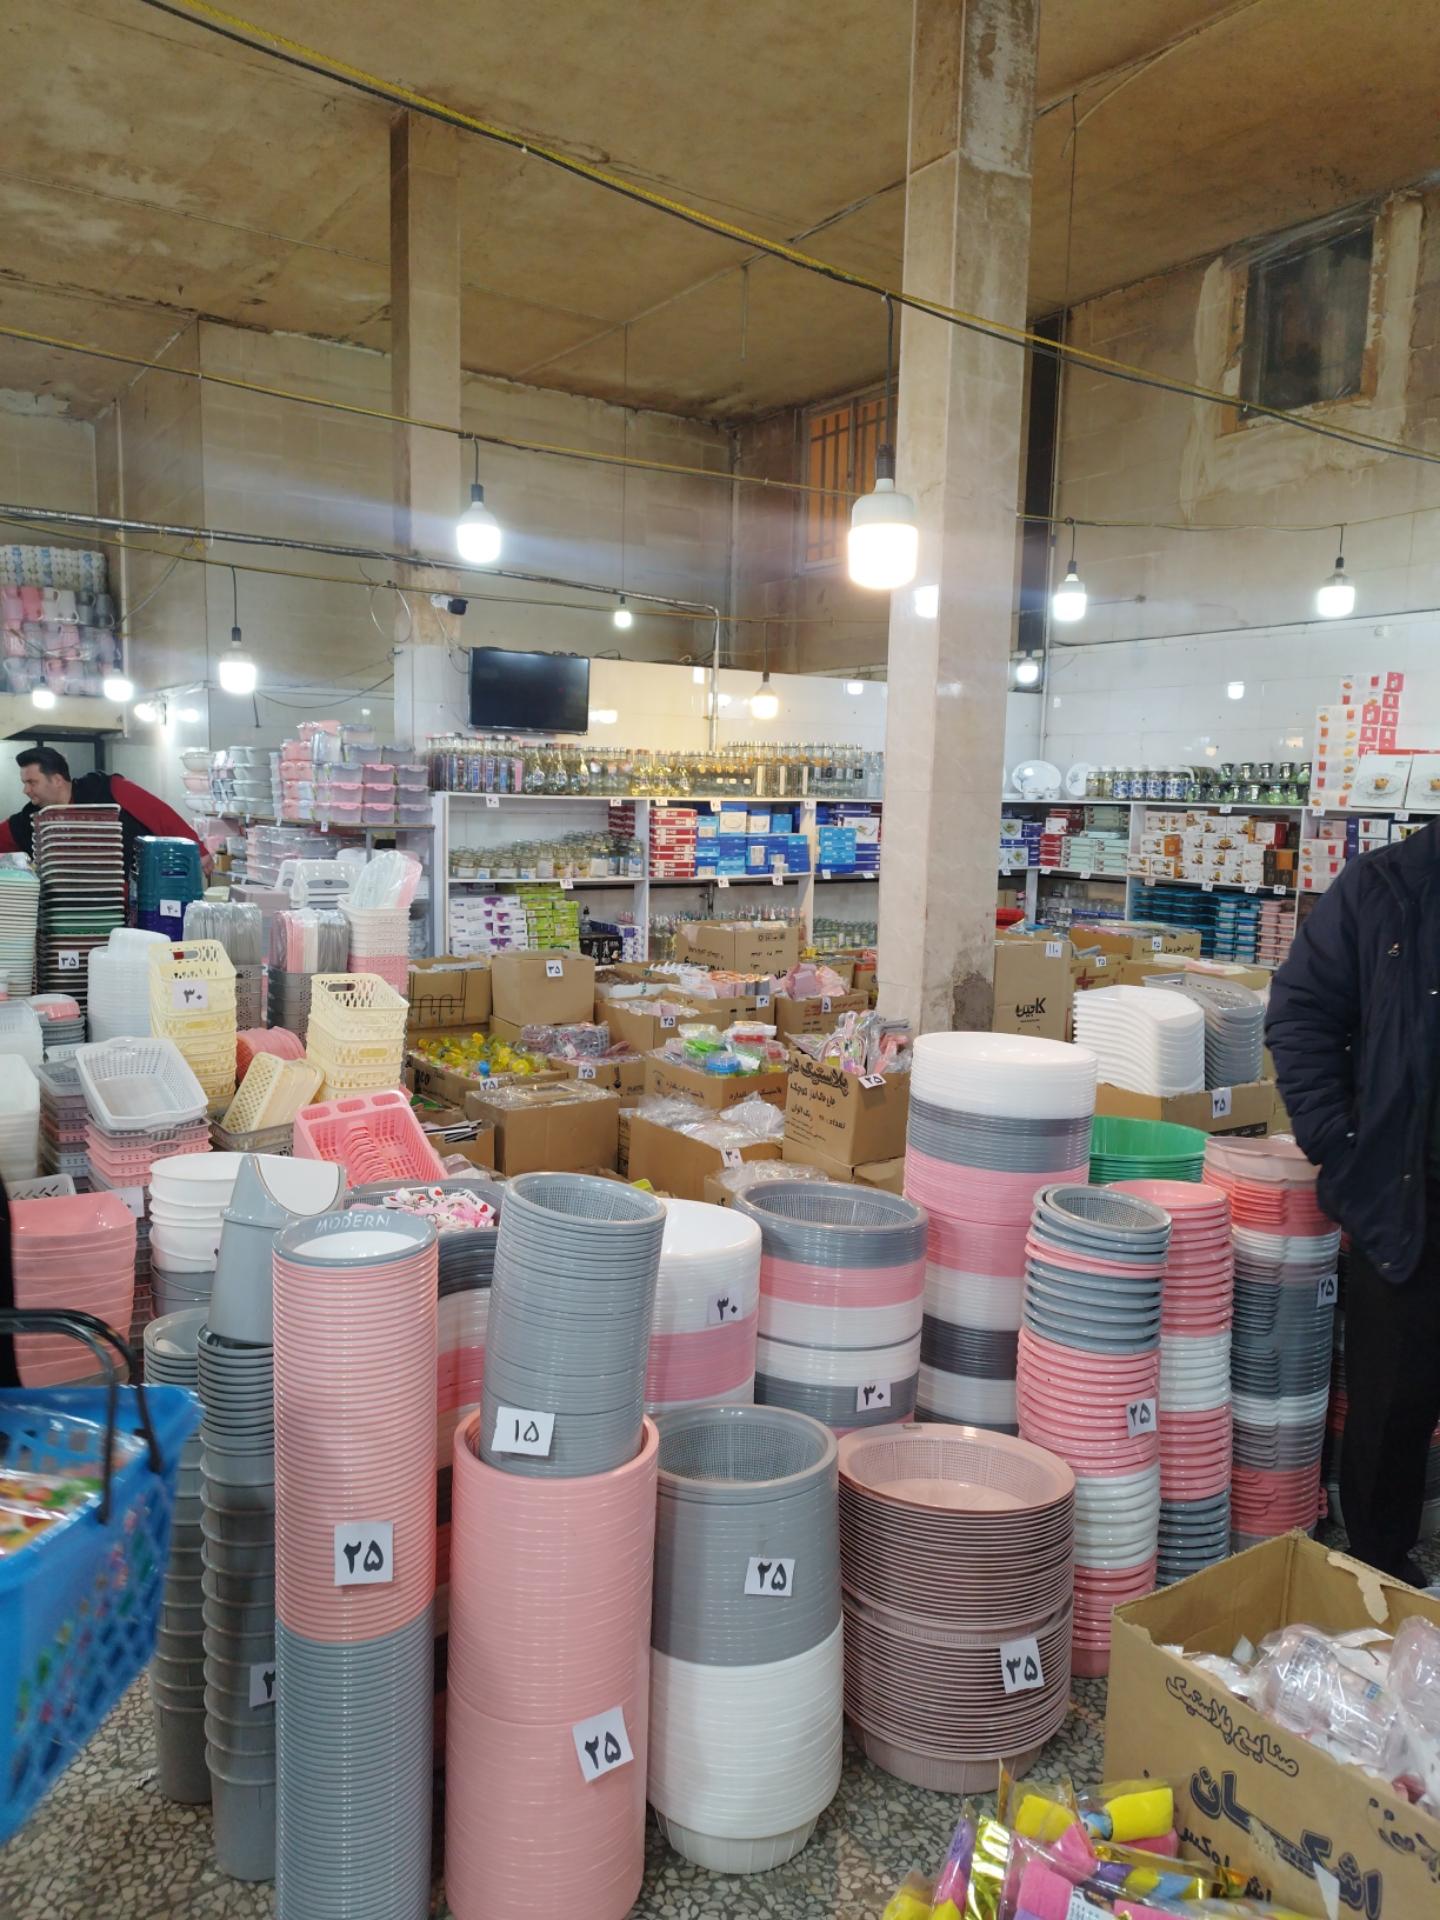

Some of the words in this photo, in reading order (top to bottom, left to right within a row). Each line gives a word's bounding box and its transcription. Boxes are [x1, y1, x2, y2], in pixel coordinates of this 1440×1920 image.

[184, 988, 203, 1004] ۳۰
[314, 1212, 392, 1234] MODERN
[716, 1296, 739, 1321] ۳۰
[863, 1384, 884, 1407] ۳۰
[1129, 1401, 1152, 1427] ۲۵
[514, 1418, 540, 1443] ۱۵
[343, 1539, 384, 1574] ۲۵
[757, 1561, 787, 1591] ۲۵
[1005, 1654, 1039, 1684] ۳۵
[1165, 1676, 1233, 1745] پلاستیک
[584, 1731, 623, 1771] ۲۵
[1232, 1724, 1300, 1777] صنایع
